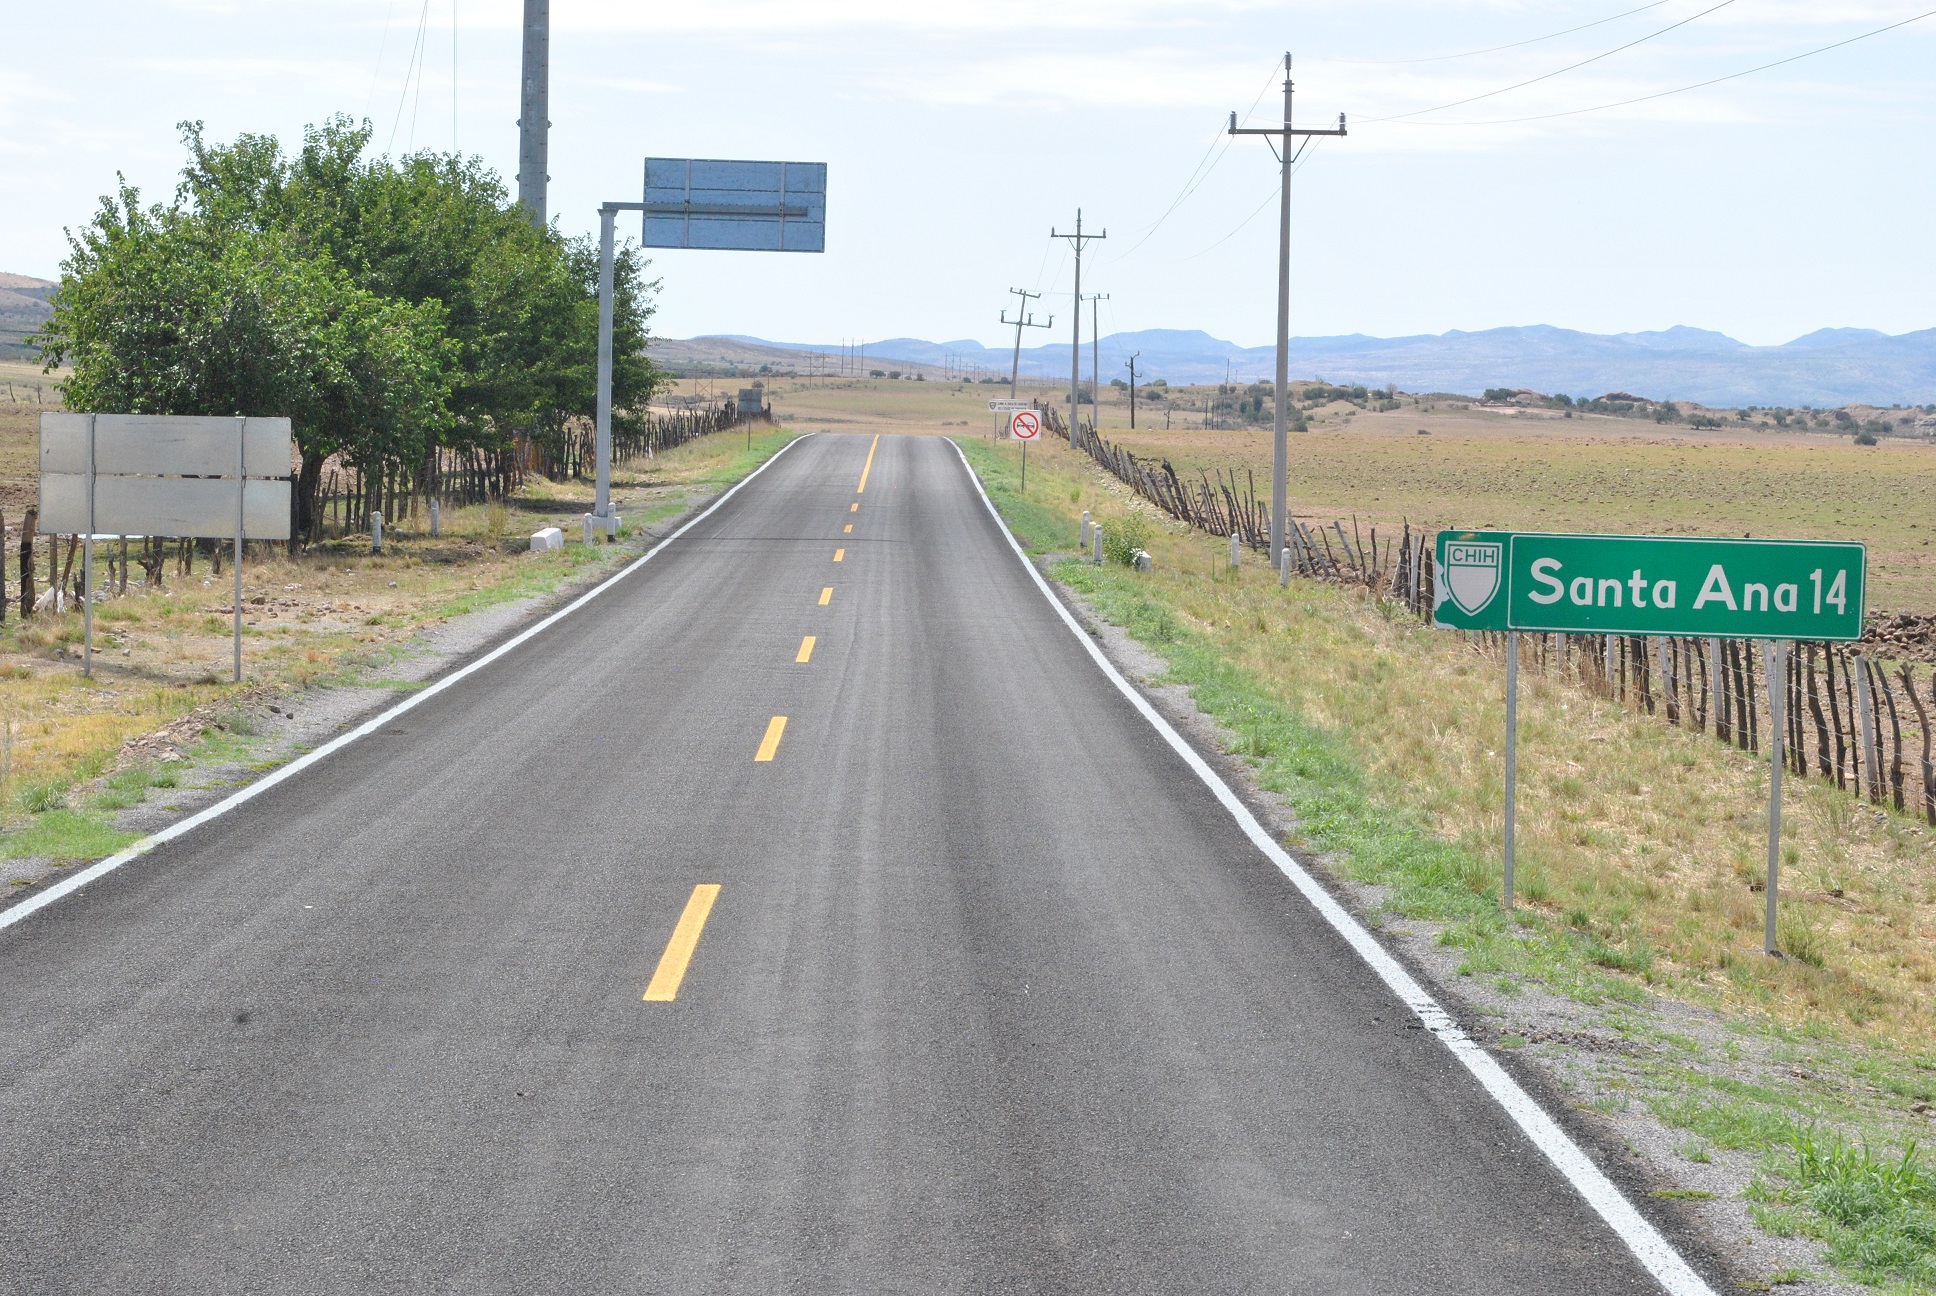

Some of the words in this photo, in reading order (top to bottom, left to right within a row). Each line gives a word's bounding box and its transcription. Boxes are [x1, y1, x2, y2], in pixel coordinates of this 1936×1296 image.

[1452, 548, 1495, 563] CHIH
[1527, 557, 1677, 609] Santa
[1692, 564, 1798, 612] Ana
[1809, 568, 1847, 615] 14
